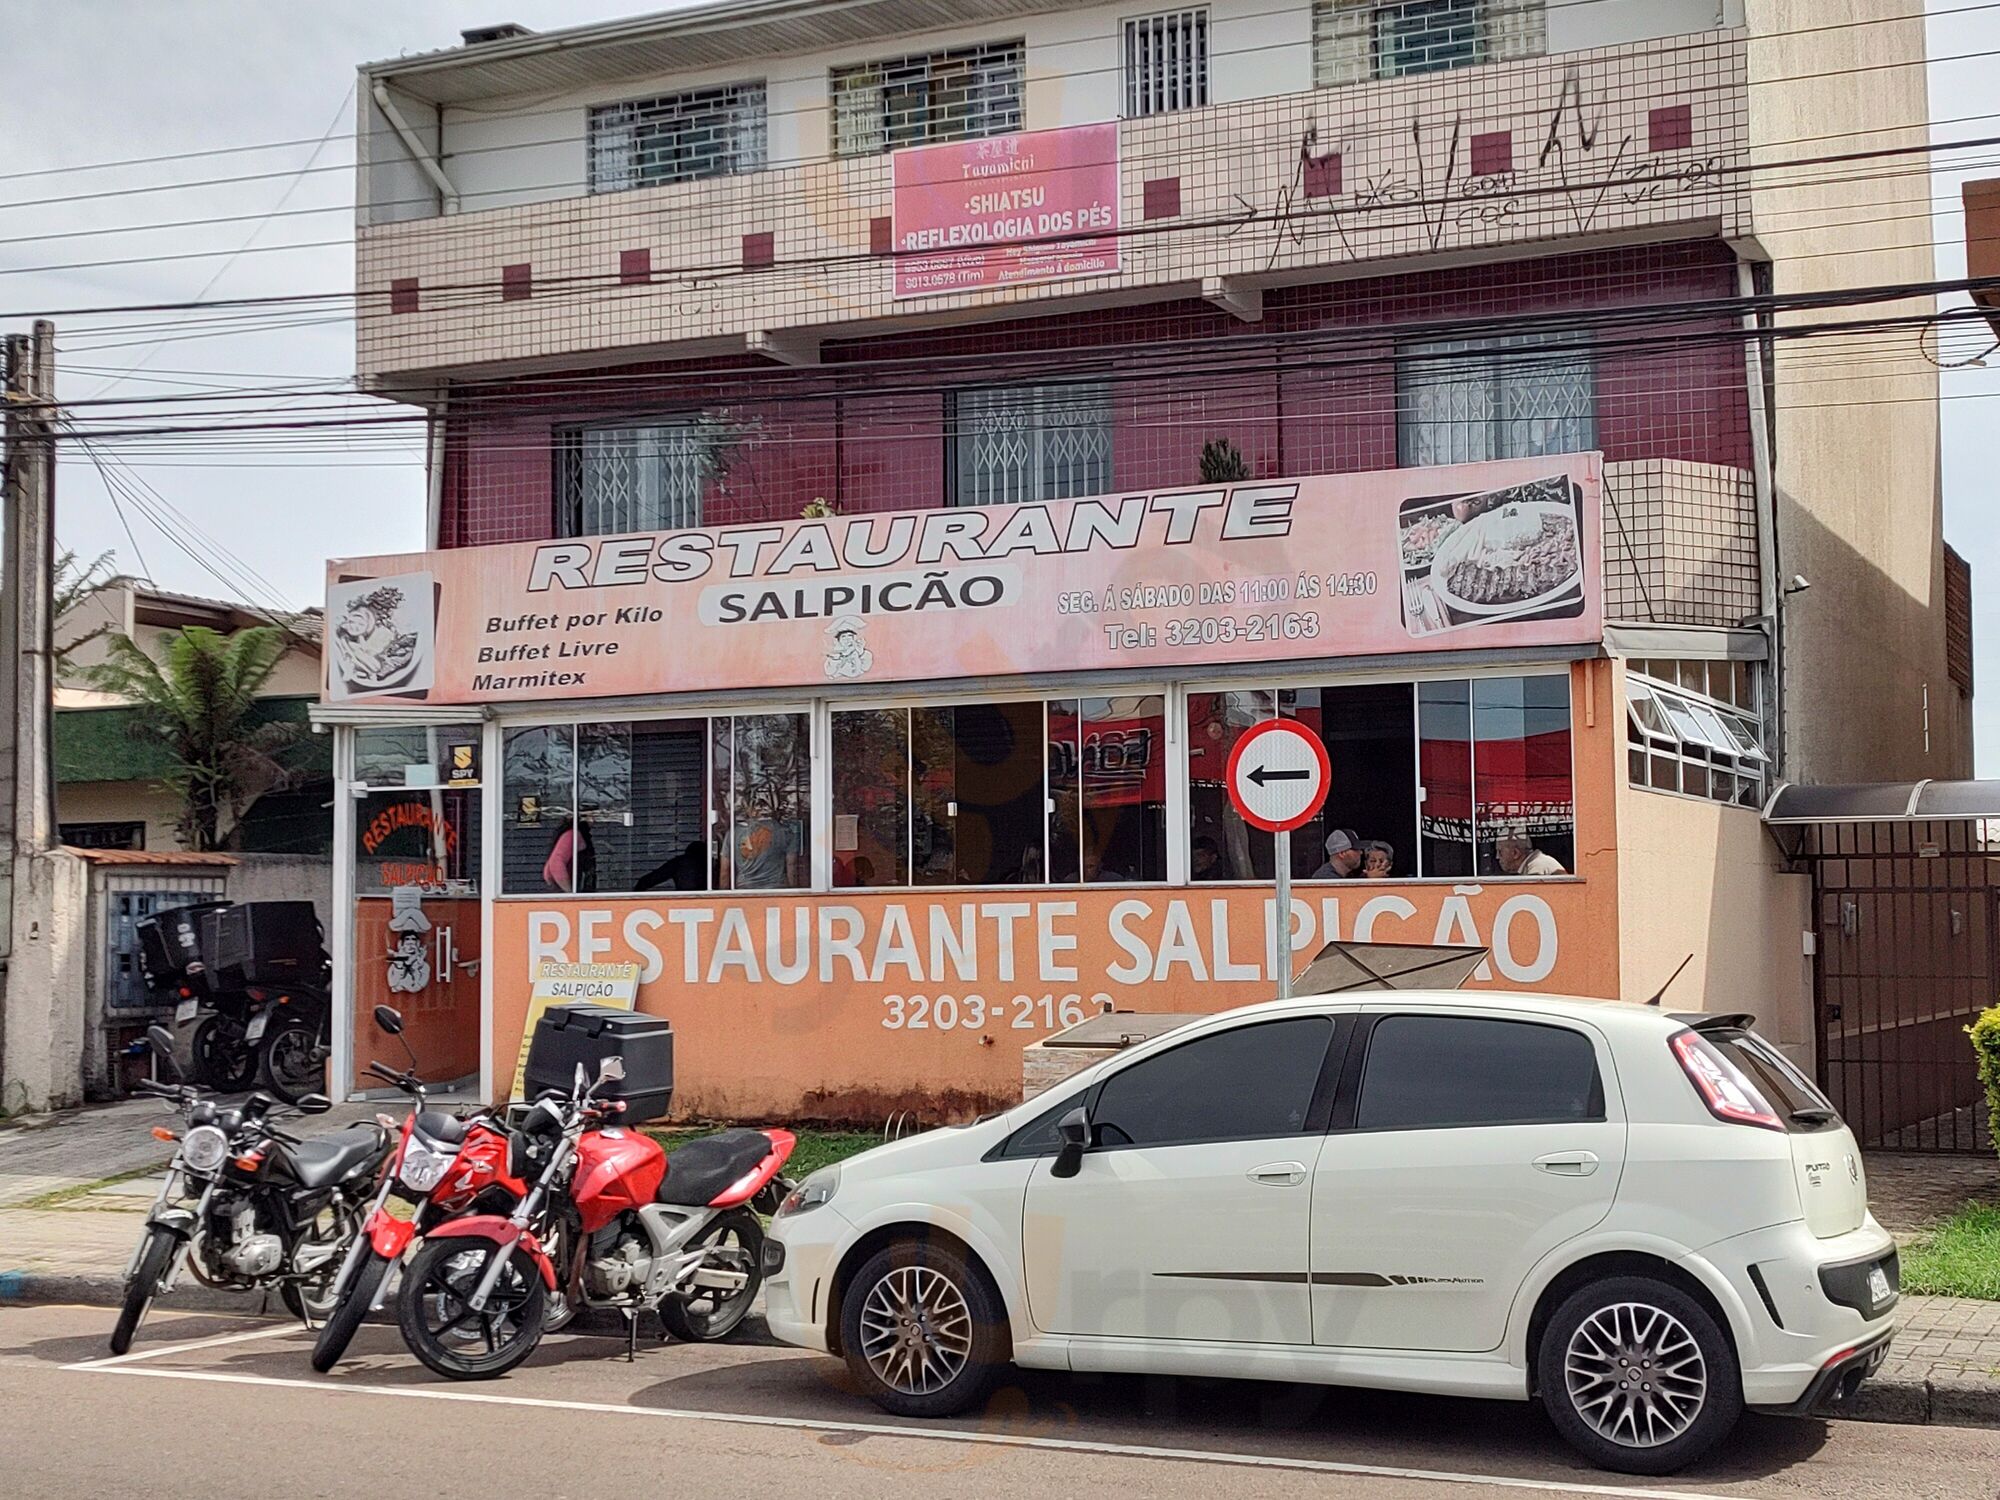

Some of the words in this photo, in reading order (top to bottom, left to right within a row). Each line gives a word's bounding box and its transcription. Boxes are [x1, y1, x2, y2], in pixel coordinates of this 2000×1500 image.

[969, 185, 1045, 216] SHIATSU
[906, 219, 1036, 251] REFLEXOLOGIA
[1038, 211, 1074, 236] DOS
[1077, 201, 1112, 229] PÉS
[957, 269, 985, 284] (Tim)
[528, 484, 1299, 592] RESTAURANTE
[719, 571, 1004, 623] SALPICÃO
[1057, 591, 1099, 614] SEG.
[1120, 580, 1194, 610] SÁBADO
[1199, 581, 1236, 604] DAS
[1239, 578, 1290, 603] 11:00
[1326, 571, 1378, 597] 14:30
[486, 612, 559, 634] Buffet
[565, 613, 608, 632] por
[614, 604, 663, 626] Kilo
[1104, 622, 1157, 649] Tel:
[1164, 611, 1321, 646] 3203-2163
[477, 639, 551, 664] Buffet
[557, 638, 620, 659] Livre
[471, 668, 586, 693] Marmitex
[452, 769, 474, 779] SPY
[528, 902, 1078, 984] RESTAURANTE
